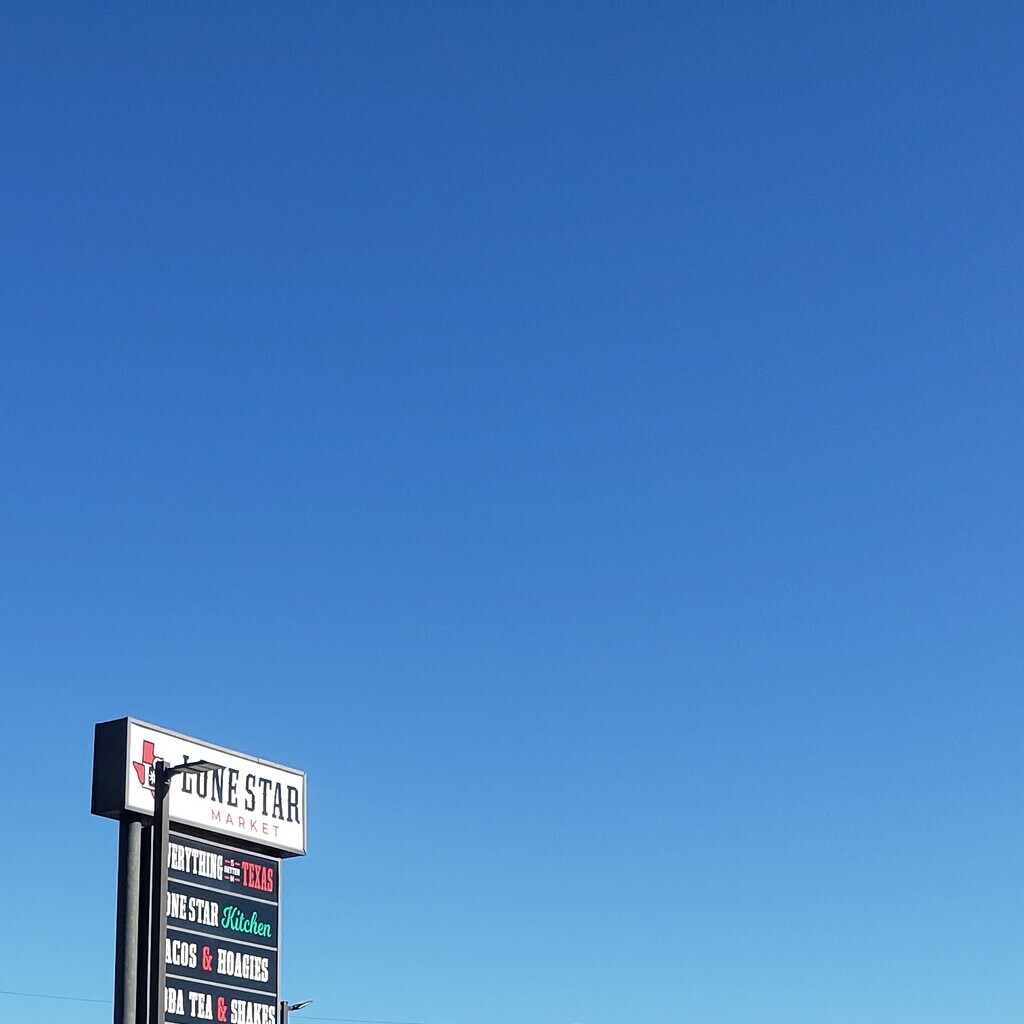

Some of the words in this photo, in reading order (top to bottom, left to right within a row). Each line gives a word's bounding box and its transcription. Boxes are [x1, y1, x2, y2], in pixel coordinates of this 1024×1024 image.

[181, 755, 240, 808] LONE
[245, 776, 301, 824] STAR
[211, 808, 280, 837] MARKET
[166, 842, 223, 881] ERYTHING
[241, 861, 274, 893] TEXAS
[166, 891, 187, 920] NE
[188, 897, 219, 927] STAR
[221, 905, 272, 938] Kitchen
[165, 938, 197, 969] ACOS
[202, 946, 213, 971] &
[217, 949, 269, 983] HOAGIES
[164, 986, 185, 1015] BA
[189, 991, 213, 1020] TEA
[217, 996, 227, 1022] &
